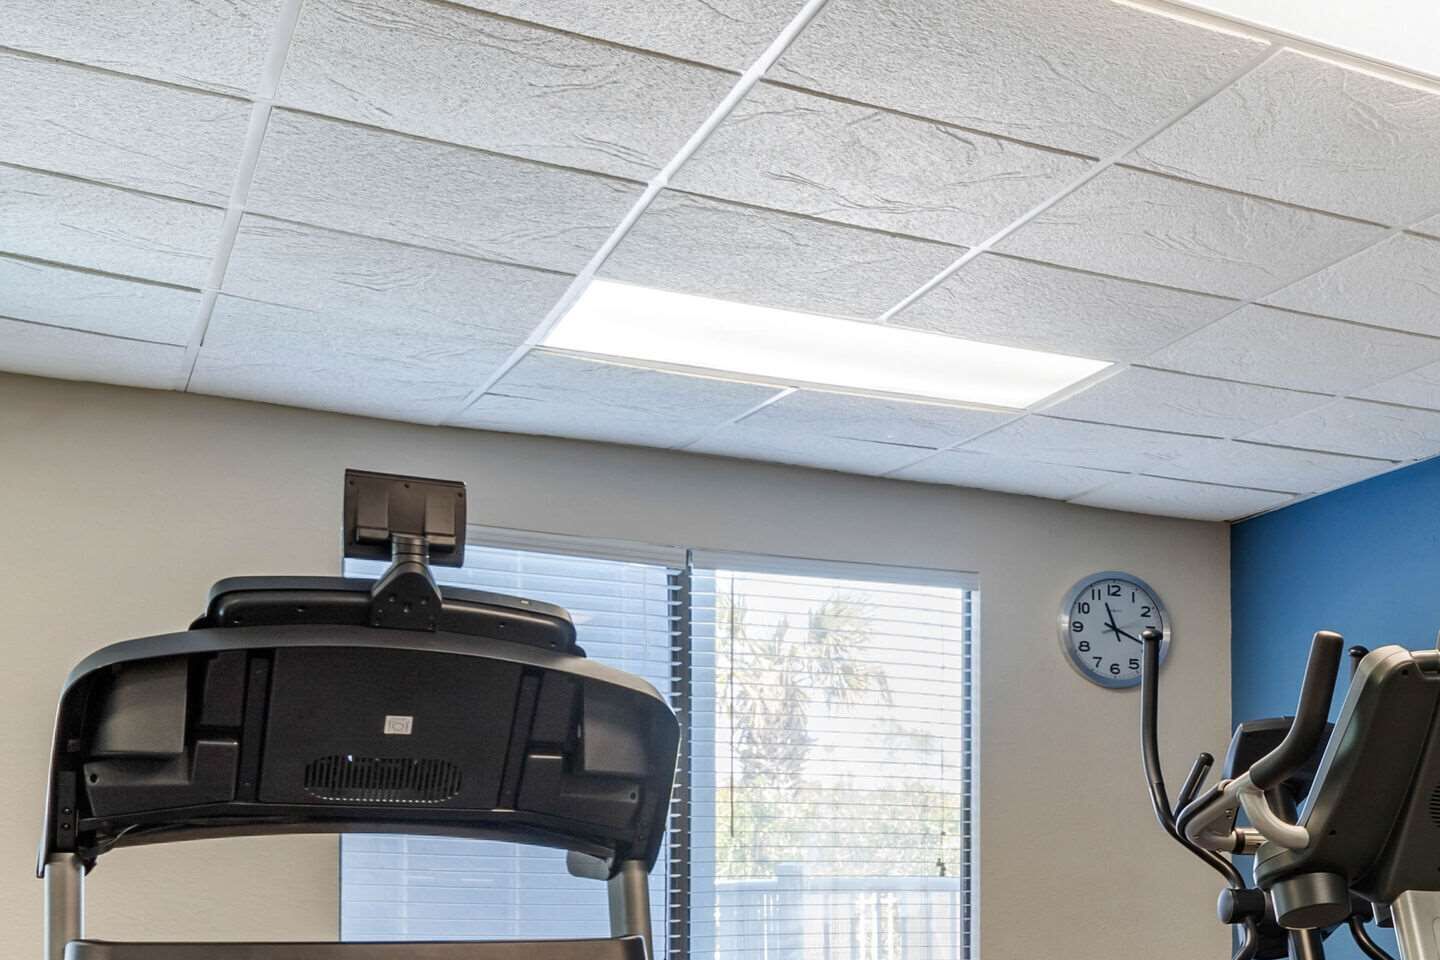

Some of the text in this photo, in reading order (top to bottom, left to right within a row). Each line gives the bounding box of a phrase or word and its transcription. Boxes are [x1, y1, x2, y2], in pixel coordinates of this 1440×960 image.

[1092, 589, 1101, 600] 11
[1107, 585, 1121, 596] 12
[1078, 602, 1090, 614] 10
[1140, 606, 1151, 617] 2
[1072, 621, 1084, 632] 9
[1078, 641, 1090, 652] 8
[1092, 656, 1102, 668] 7
[1128, 659, 1140, 670] 5
[1110, 664, 1120, 675] 6
